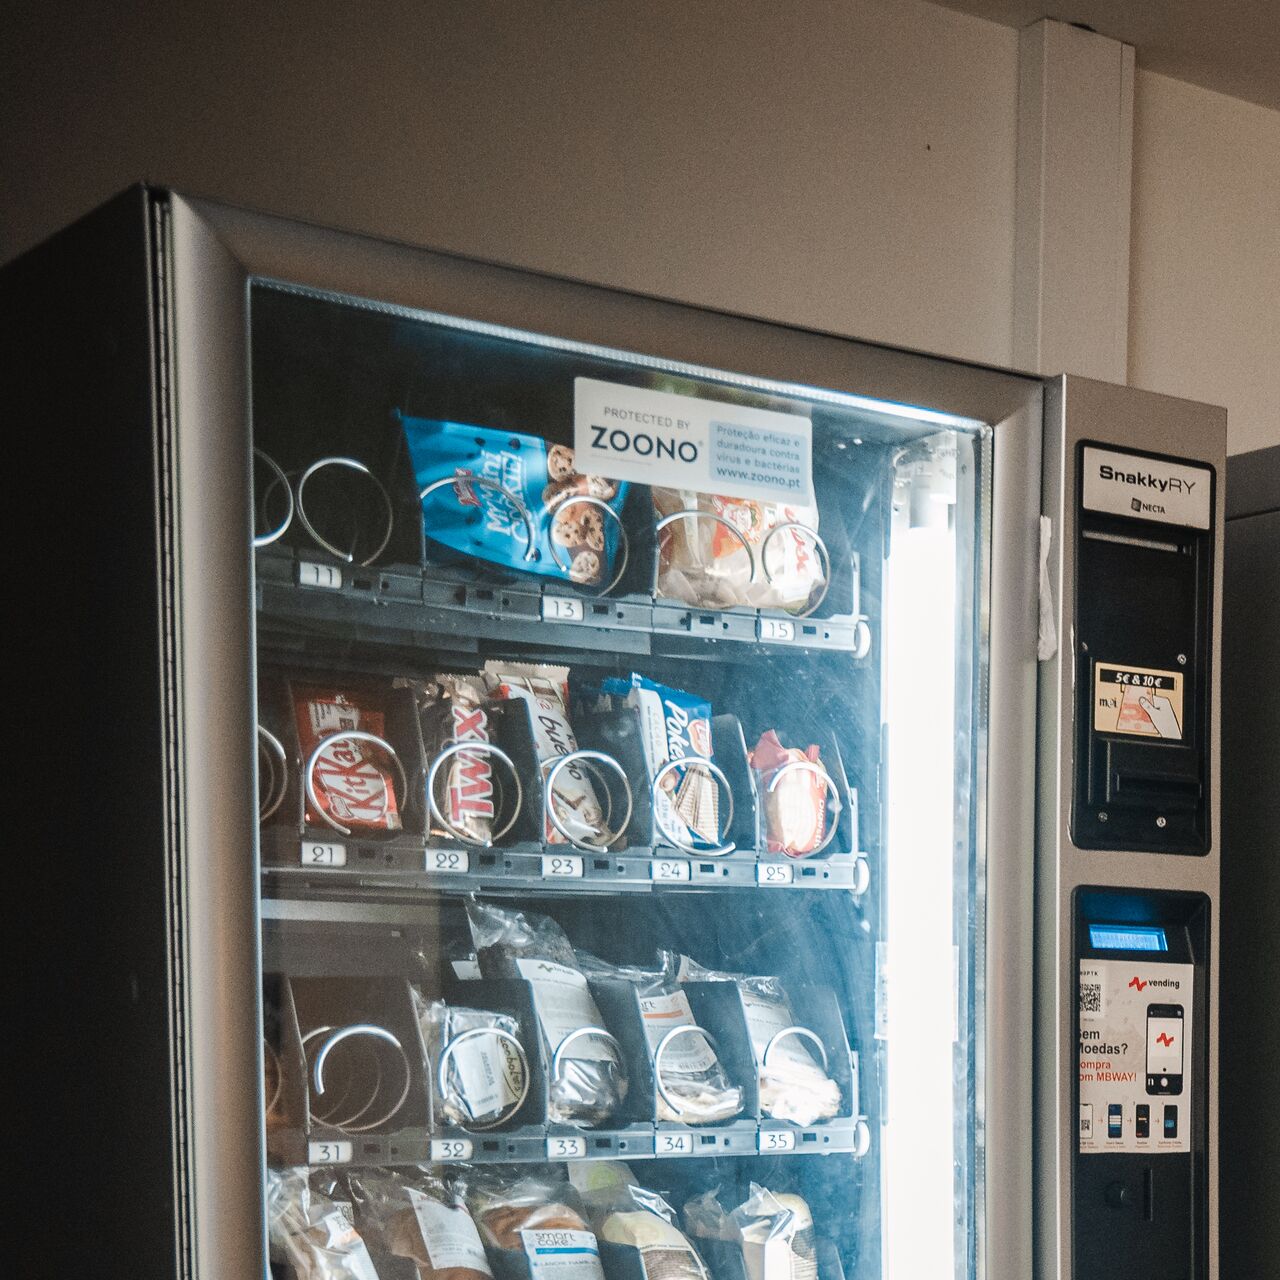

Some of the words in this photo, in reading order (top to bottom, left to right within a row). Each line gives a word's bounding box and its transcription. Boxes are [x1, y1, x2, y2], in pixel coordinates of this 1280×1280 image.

[604, 406, 673, 428] PROTECTED
[677, 419, 691, 430] BY
[590, 425, 698, 463] ZOONO
[763, 432, 791, 445] eficaz
[717, 439, 767, 456] duradoura
[770, 446, 801, 461] contra
[716, 466, 801, 489] www.zoono.pt
[1142, 503, 1166, 514] NECTA
[313, 567, 333, 585] 11
[553, 601, 575, 618] 13
[769, 622, 788, 638] 15
[1132, 674, 1141, 686] &
[450, 706, 494, 825] TWIX
[312, 846, 334, 864] 21
[435, 853, 460, 870] 22
[551, 858, 575, 875] 23
[660, 864, 680, 879] 24
[765, 865, 787, 882] 25
[1148, 979, 1180, 990] vending
[1080, 1061, 1112, 1076] ompra
[1080, 1074, 1096, 1082] om
[1096, 1071, 1137, 1083] MBWAY!
[441, 1142, 465, 1158] 32
[556, 1139, 578, 1156] 33
[663, 1136, 686, 1152] 34
[766, 1134, 788, 1149] 35
[318, 1144, 341, 1162] 31
